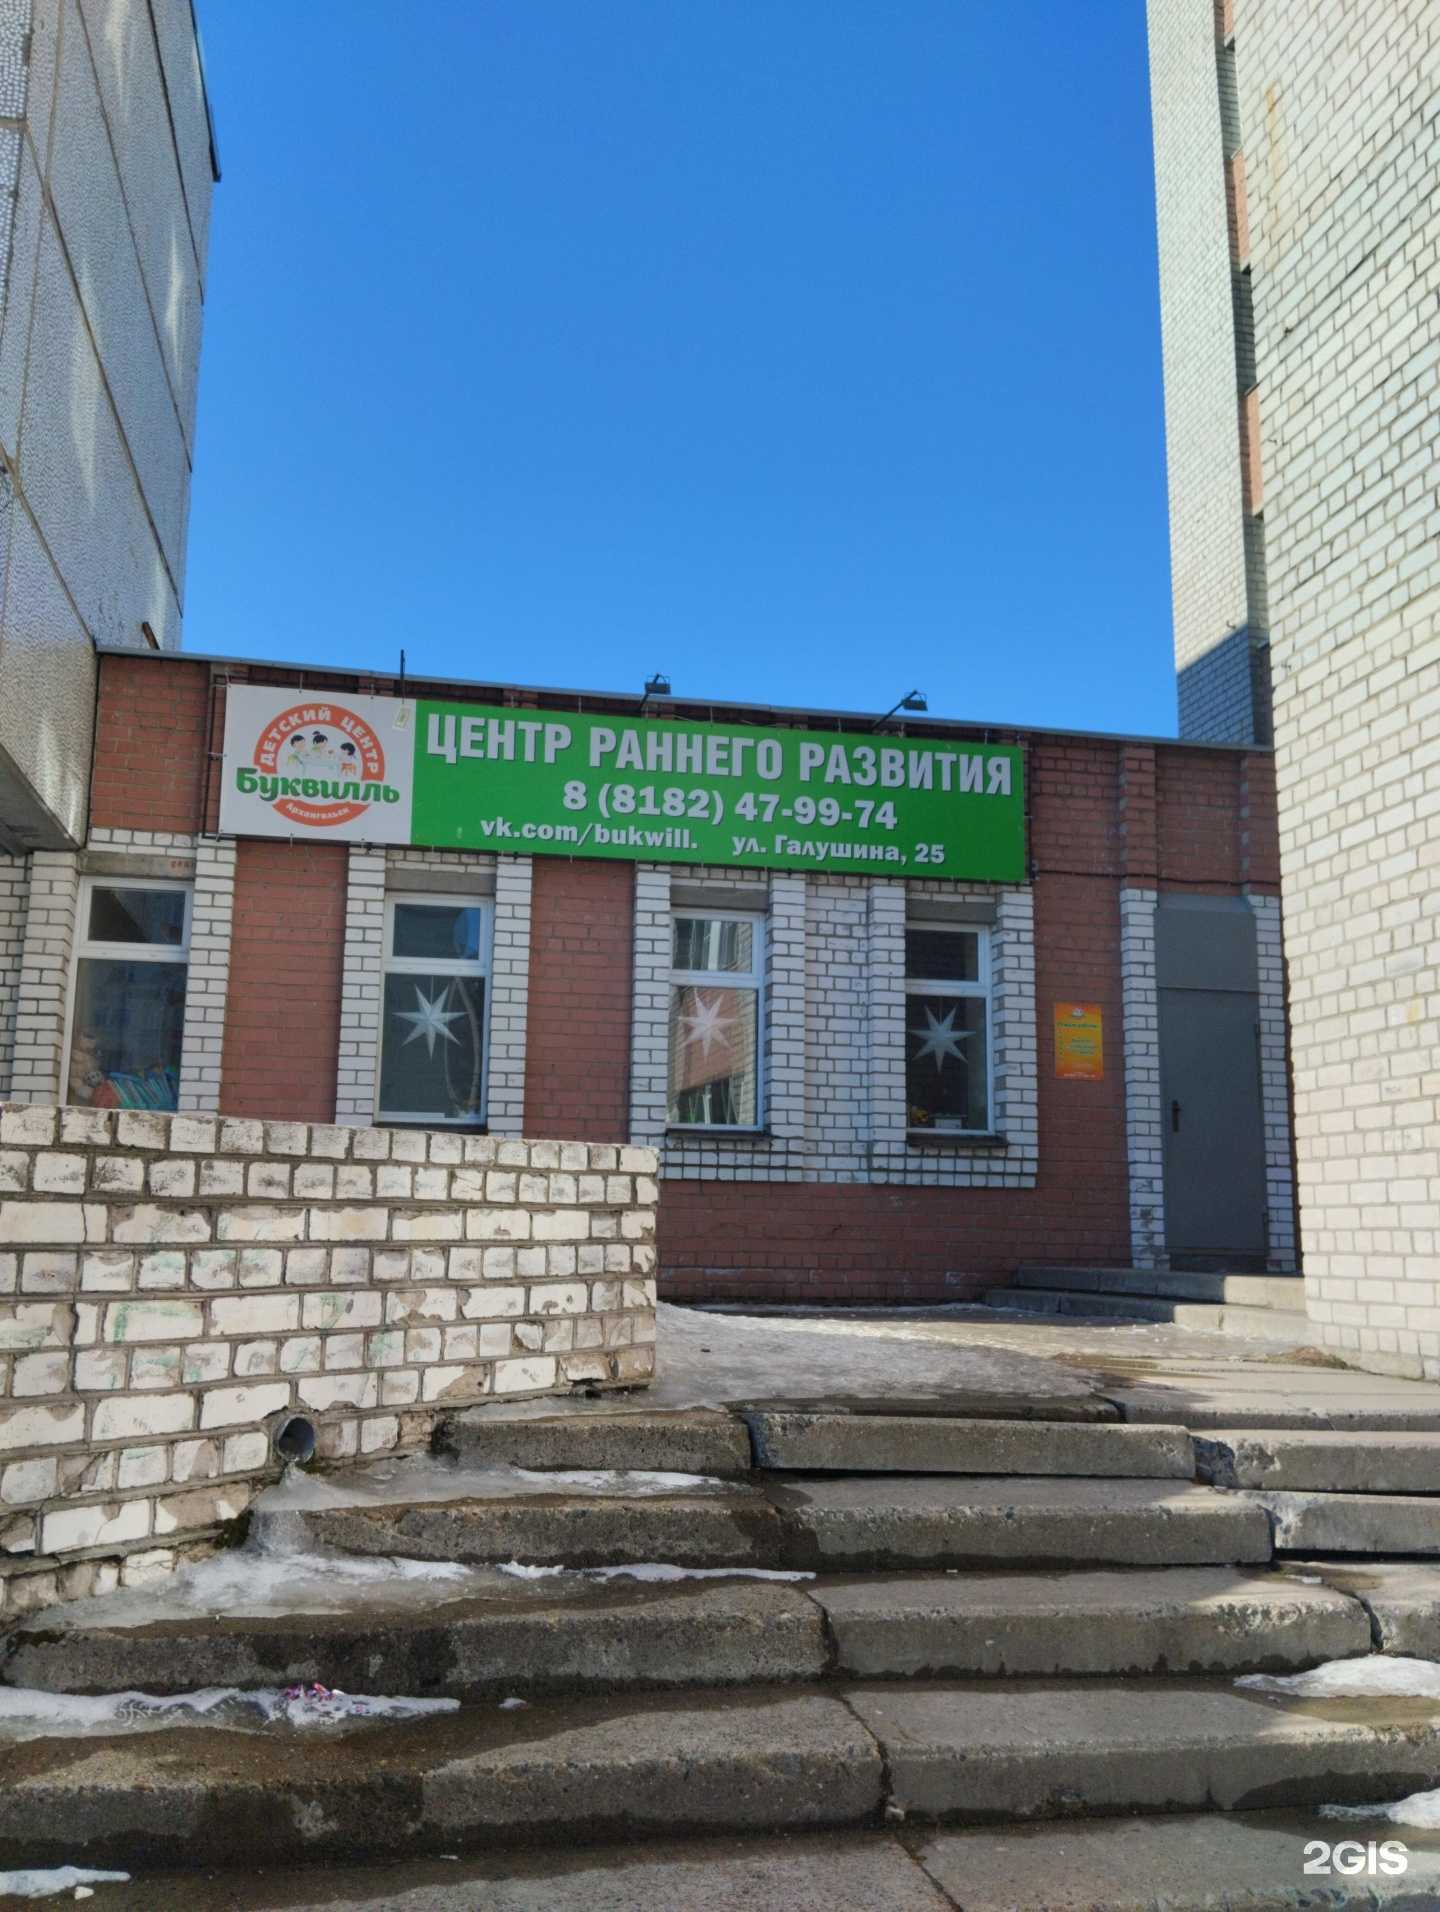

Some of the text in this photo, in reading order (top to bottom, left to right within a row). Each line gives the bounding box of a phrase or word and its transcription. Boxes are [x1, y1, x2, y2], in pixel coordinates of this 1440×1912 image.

[260, 706, 378, 774] ДЕТСКИЙ ЦЕНТР
[427, 713, 1012, 796] ЦЕНТР РАННЕГО РАЗВИТИЯ
[563, 782, 898, 830] 8 (8182) 47-99-74
[480, 817, 698, 849] vk.com/bukwill.
[732, 834, 946, 864] ул. Галушина, 25
